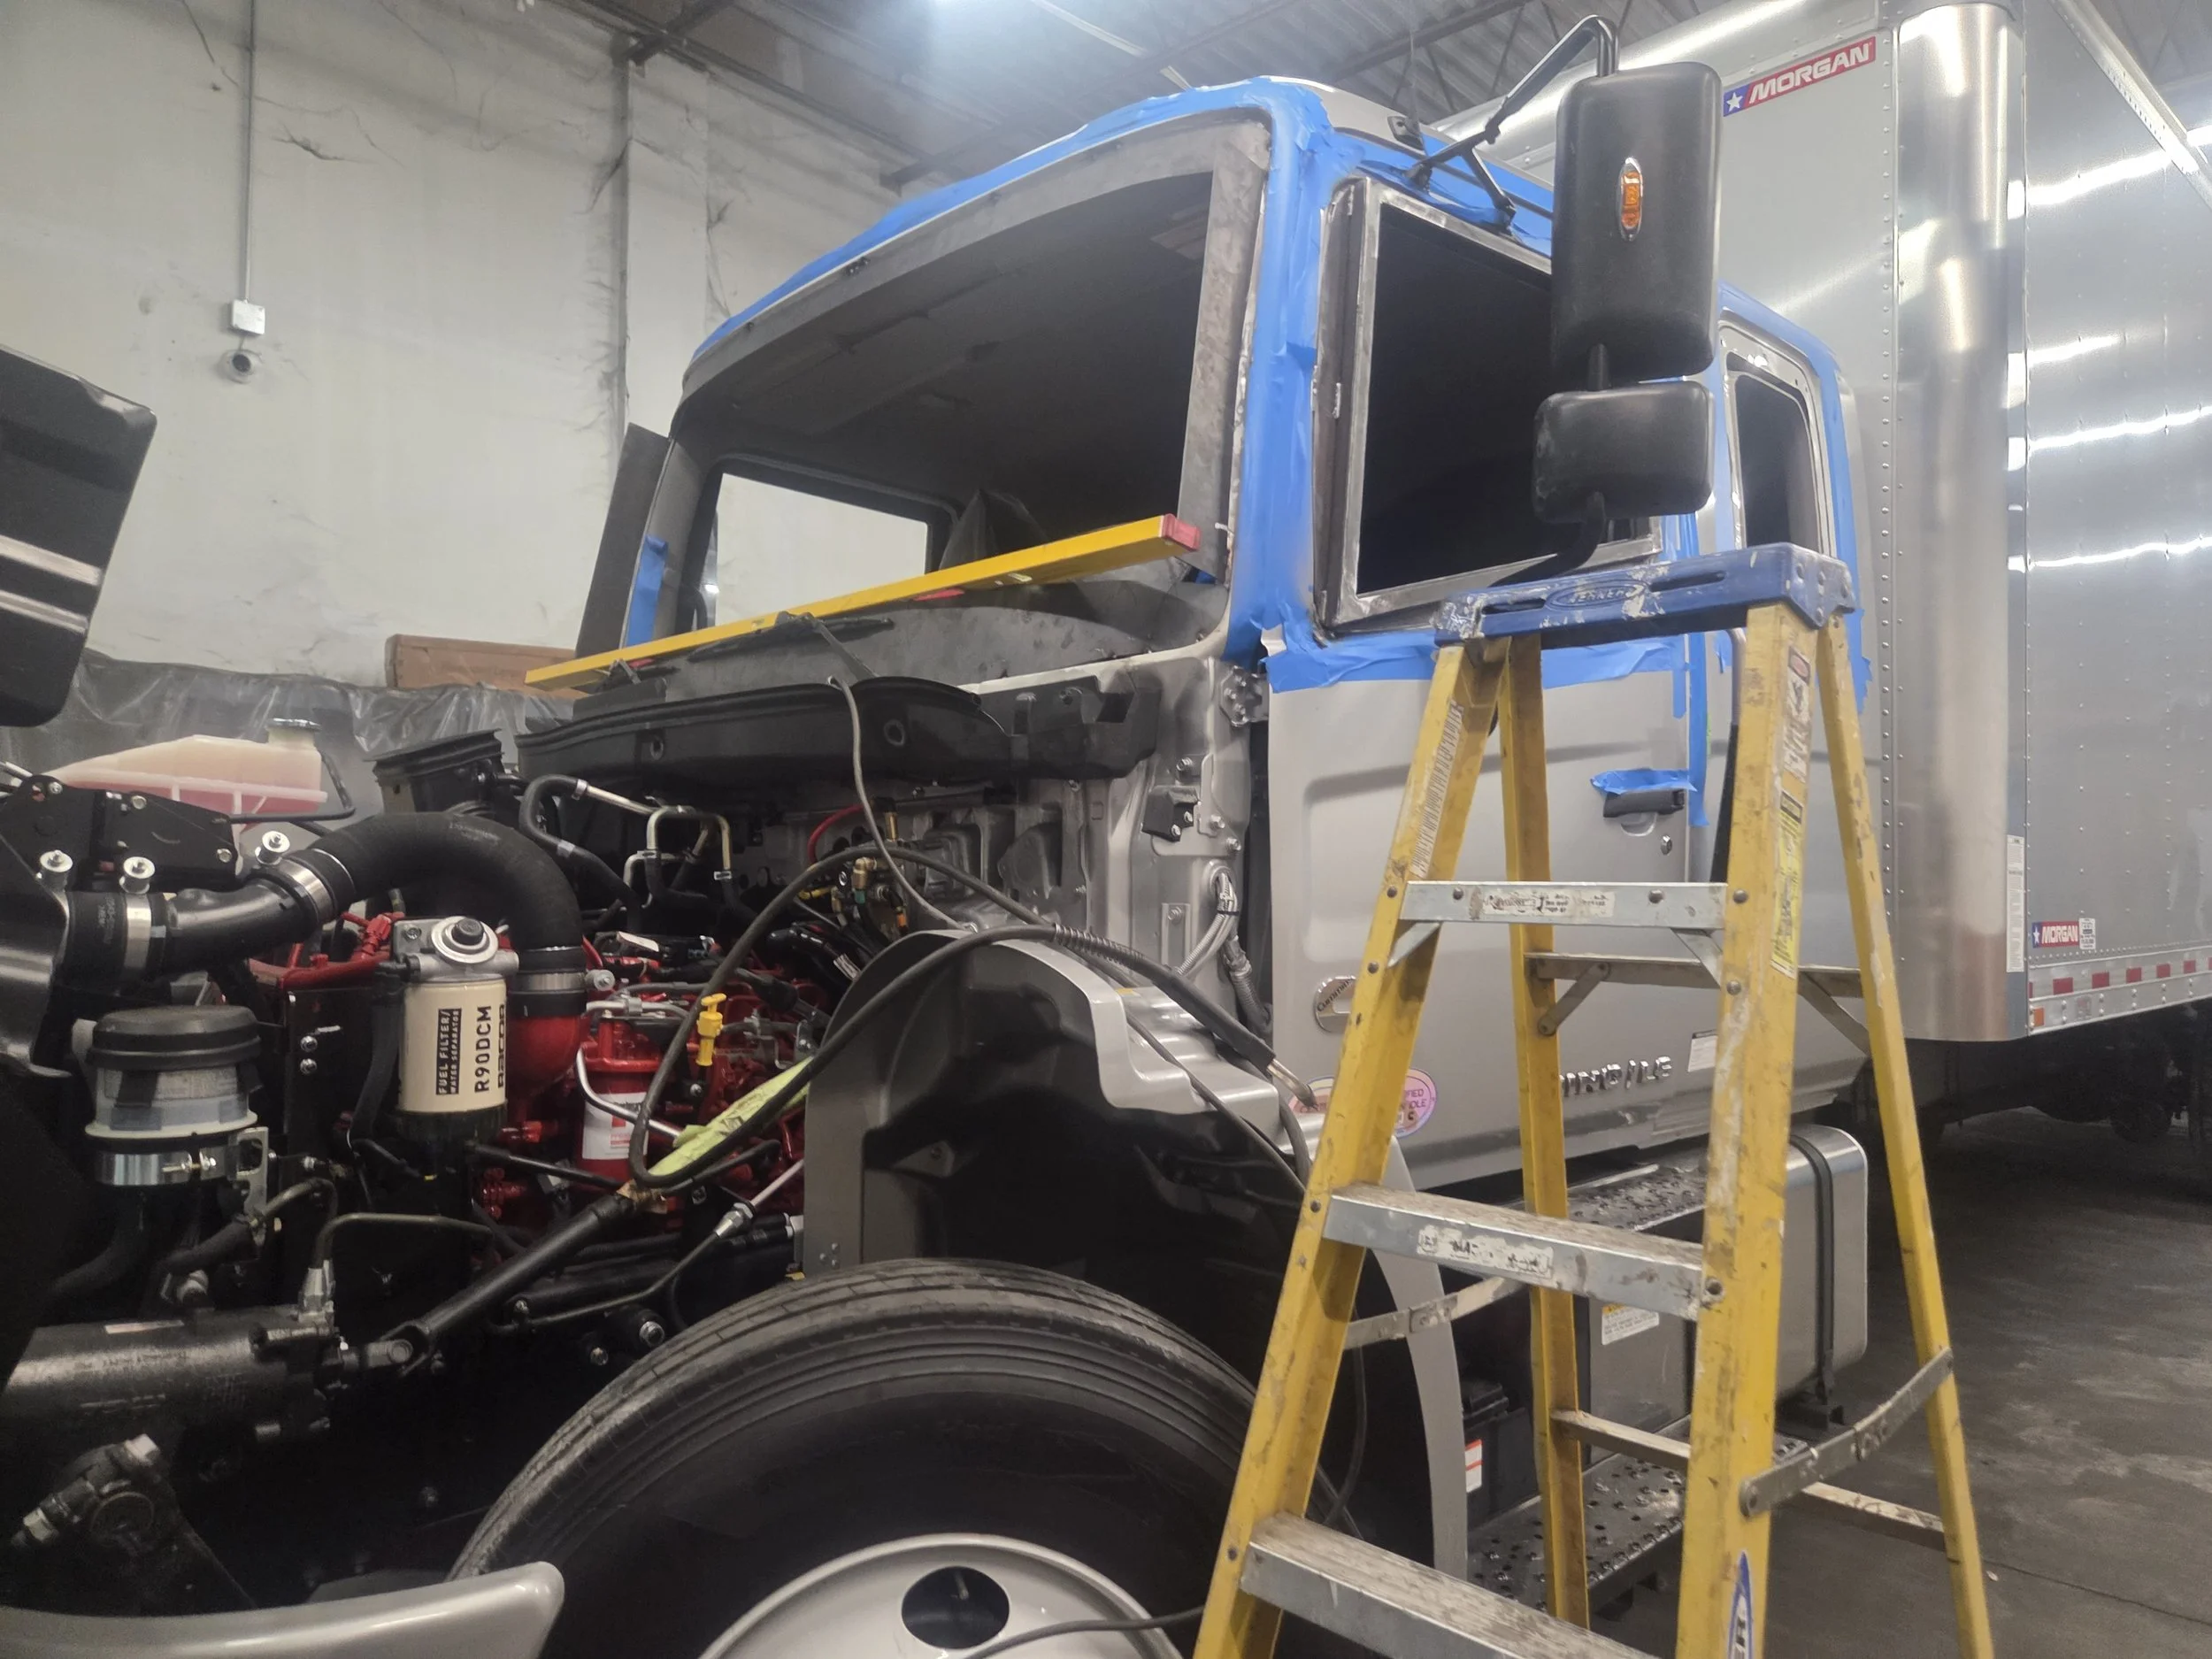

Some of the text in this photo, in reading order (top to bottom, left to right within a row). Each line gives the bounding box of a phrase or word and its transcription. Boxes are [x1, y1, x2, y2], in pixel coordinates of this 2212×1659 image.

[1749, 42, 1870, 104] MORGAN
[2041, 926, 2078, 944] MORGAN
[439, 1010, 450, 1094] FUEL FILTER/
[474, 1006, 491, 1093] R90DCM
